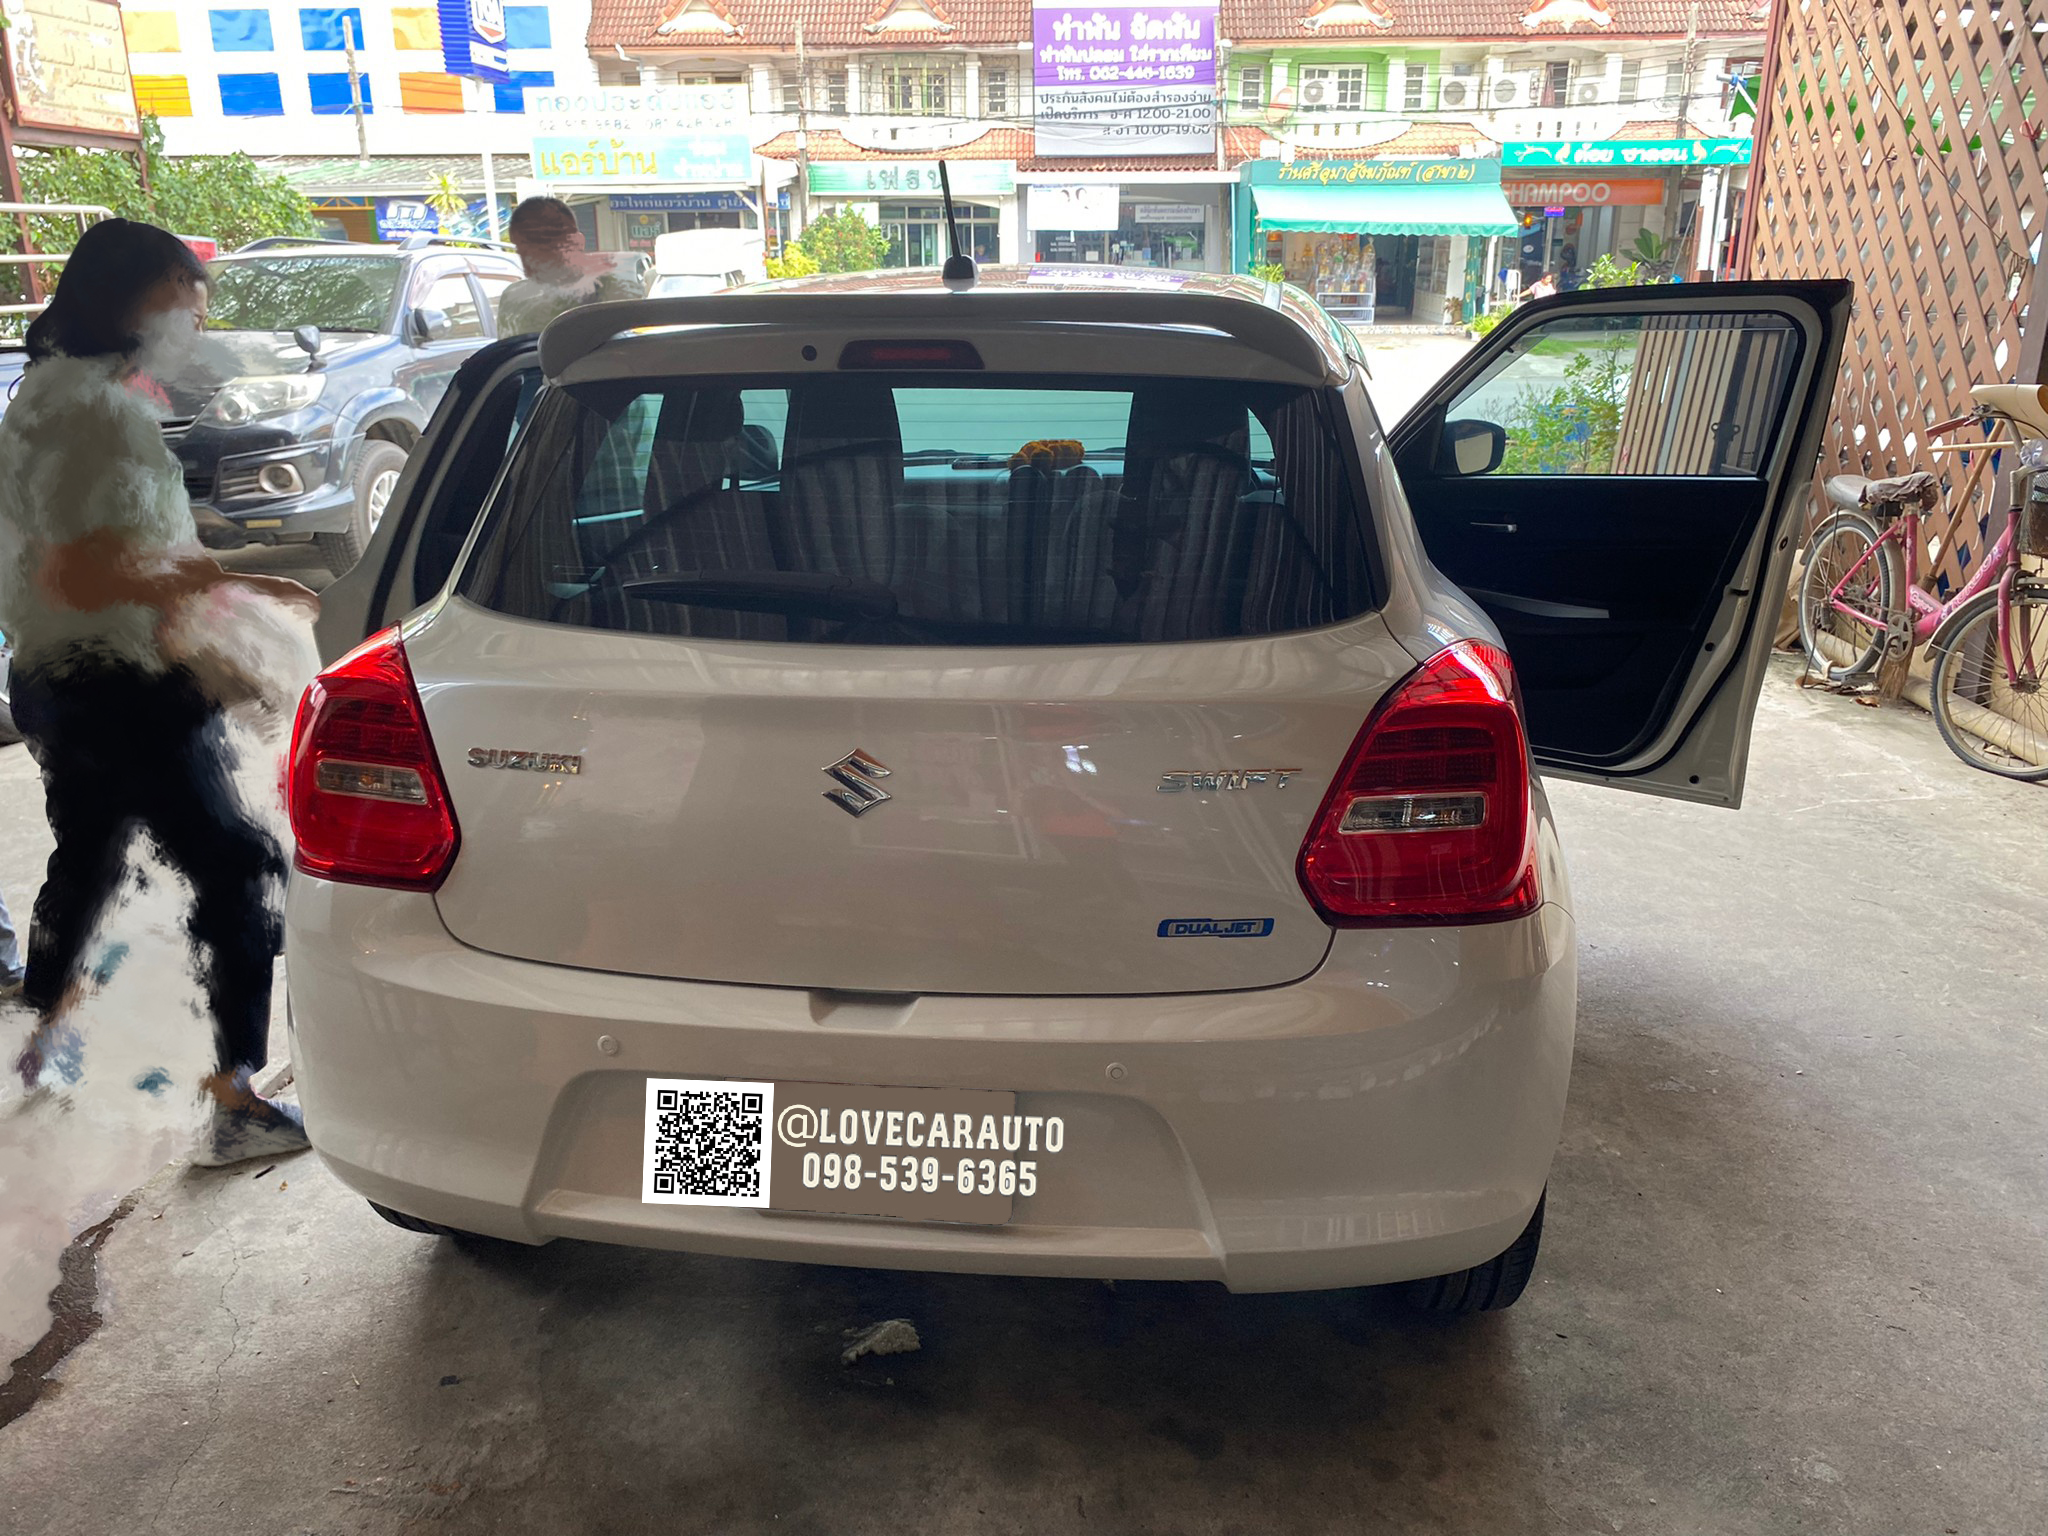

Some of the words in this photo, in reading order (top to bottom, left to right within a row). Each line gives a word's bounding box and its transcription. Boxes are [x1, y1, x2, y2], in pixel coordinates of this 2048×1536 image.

[1052, 12, 1121, 41] ทำฟัน
[1130, 11, 1201, 41] จัดฟัน
[1040, 90, 1211, 105] ประกันสังคมไม่ต้องสำรองจ่าย
[1137, 108, 1211, 119] 12.00-21.00
[540, 137, 658, 177] แอร์บ้าน
[467, 747, 581, 775] SUZUKI
[1157, 768, 1302, 793] SWIFT
